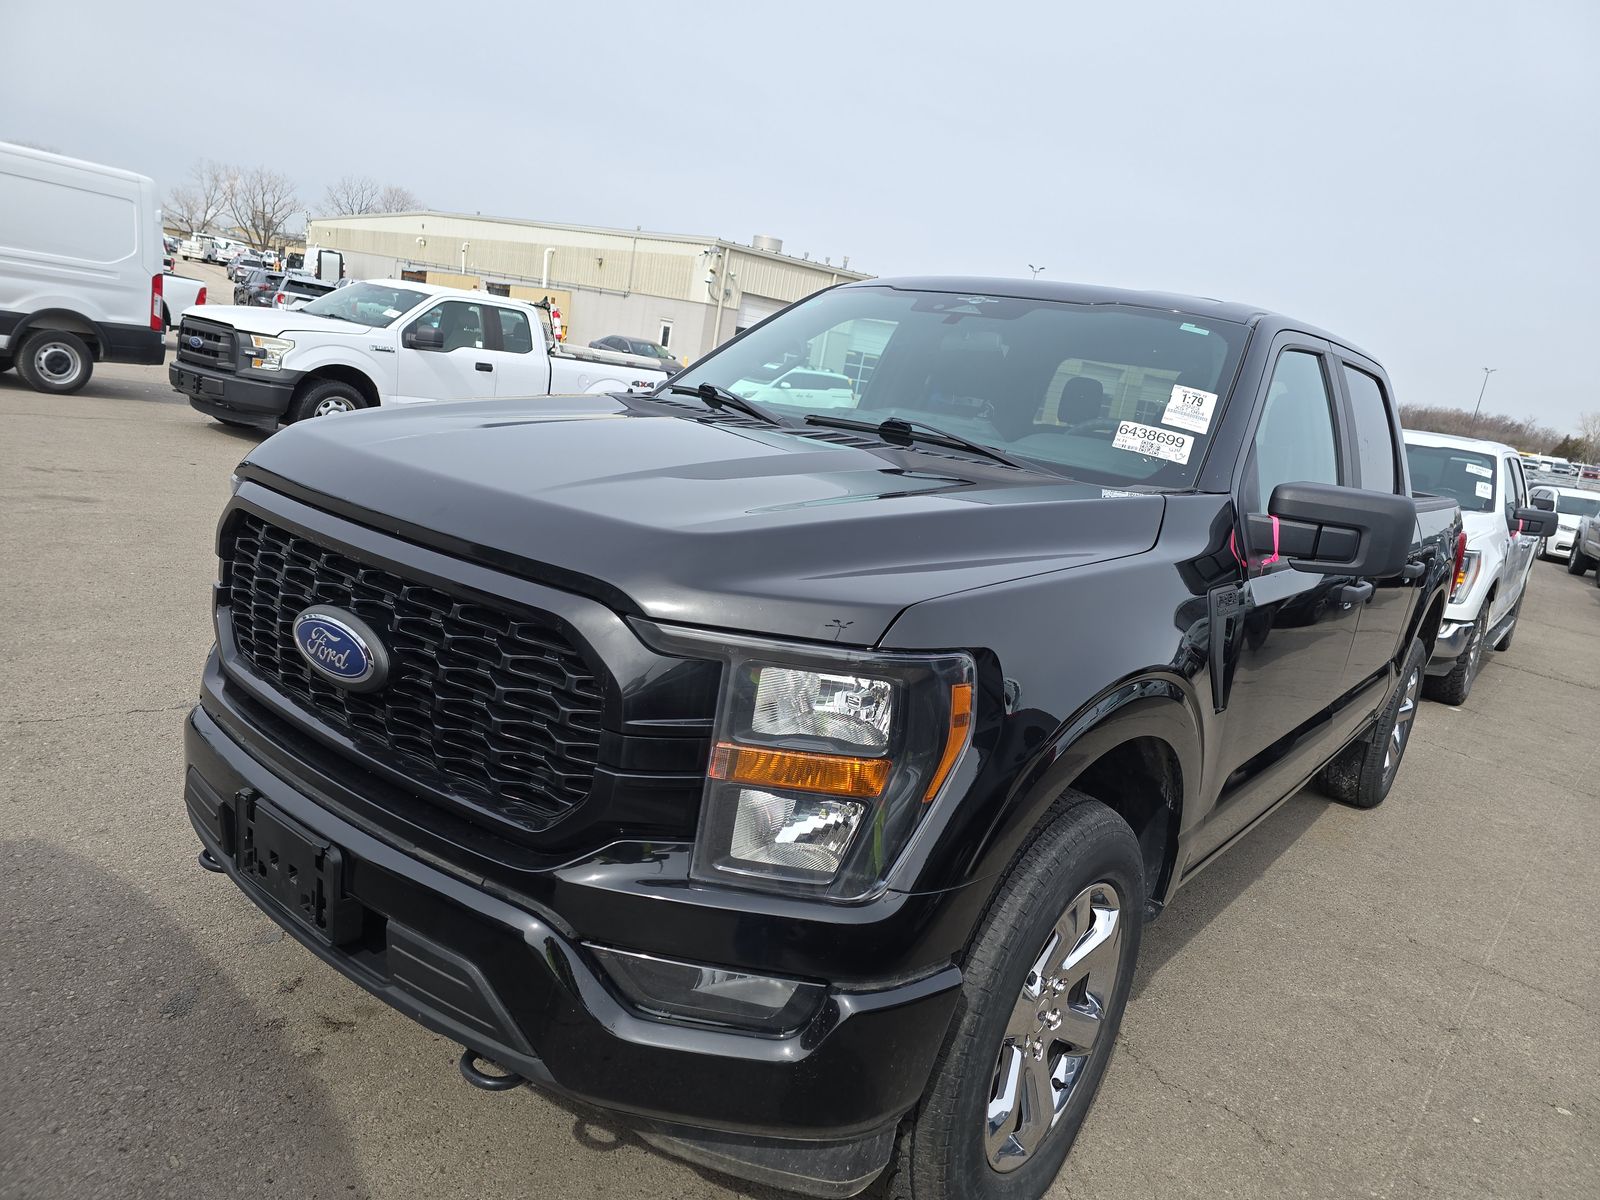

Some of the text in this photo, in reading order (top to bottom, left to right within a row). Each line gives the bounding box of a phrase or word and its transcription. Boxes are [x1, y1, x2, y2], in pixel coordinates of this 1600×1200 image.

[1182, 393, 1204, 407] 1:79
[1119, 424, 1185, 447] 6438699
[306, 626, 351, 670] Ford
